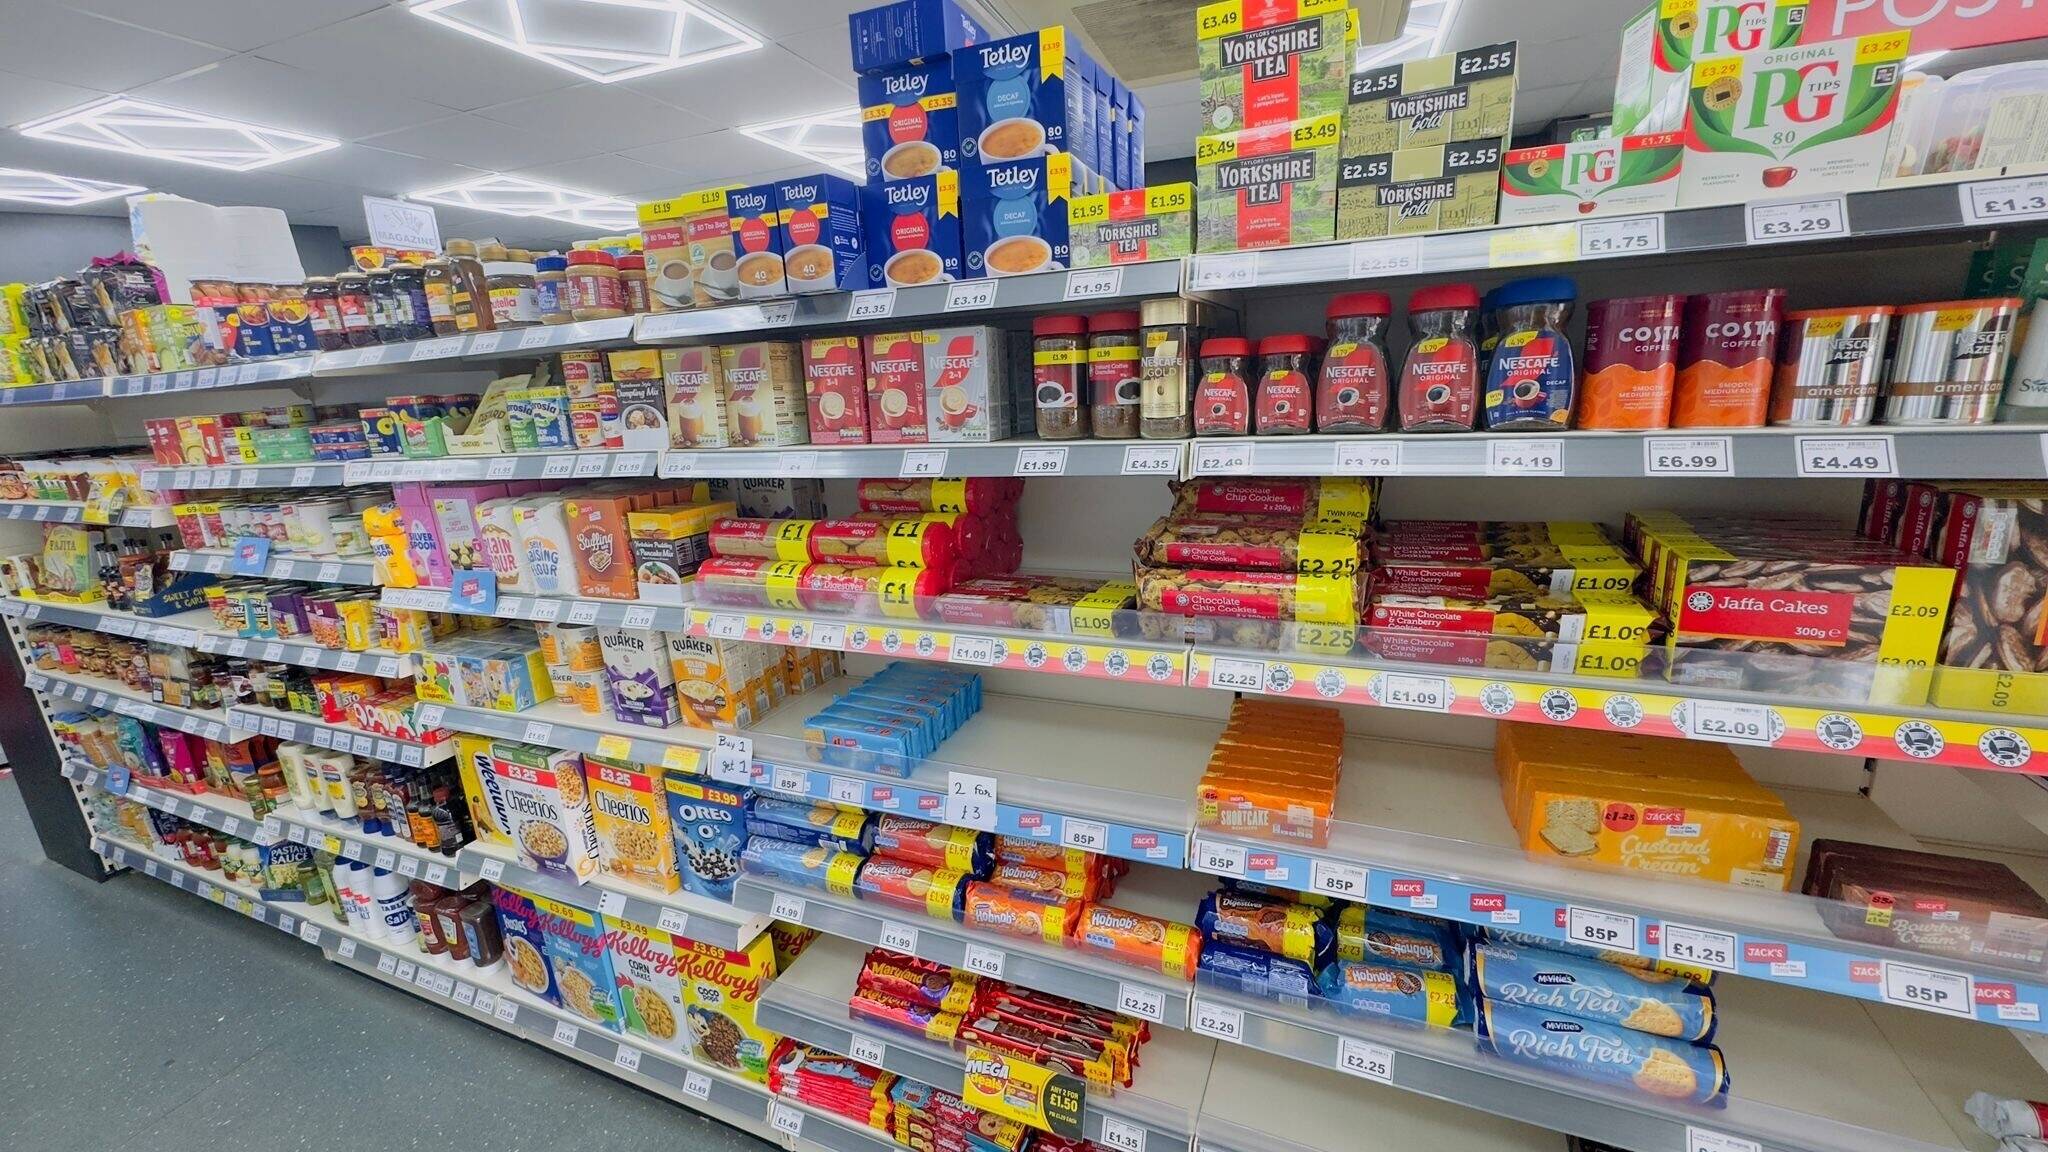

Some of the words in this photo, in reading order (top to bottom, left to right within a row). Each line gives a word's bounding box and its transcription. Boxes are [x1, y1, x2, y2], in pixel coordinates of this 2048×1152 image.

[1202, 12, 1237, 30] £3.49
[1222, 25, 1320, 64] YORKSHIRE
[979, 43, 1032, 69] Tetley
[1459, 51, 1511, 75] £2.55
[1763, 47, 1835, 65] ORIGINAL
[1253, 54, 1287, 79] TEA
[882, 74, 929, 96] Tetley
[1352, 74, 1398, 95] £2.55
[998, 92, 1019, 102] DECAF
[1744, 61, 1841, 129] PG
[1808, 79, 1841, 92] TIPS
[1390, 91, 1467, 119] YORKSHIRE
[893, 116, 922, 127] ORIGINAL
[1409, 110, 1447, 136] Gold
[1048, 127, 1062, 136] 80
[1294, 123, 1337, 141] £3.49
[1772, 131, 1796, 145] 80
[1197, 140, 1235, 159] £3.49
[1448, 147, 1497, 167] £2.55
[1220, 159, 1312, 189] YORKSHIRE
[1343, 161, 1388, 180] £2.55
[1568, 150, 1614, 185] PG
[987, 167, 1040, 190] Tetley
[782, 184, 817, 202] Tetley
[884, 184, 930, 206] Tetley
[1249, 182, 1281, 202] TEA
[1379, 181, 1454, 204] YORKSHIRE
[732, 194, 767, 211] Tetley
[1150, 193, 1185, 208] £1.95
[1003, 211, 1026, 221] DECAF
[1072, 205, 1104, 219] £1.95
[1398, 201, 1433, 225] Gold
[792, 222, 815, 230] ORIGINAL
[895, 225, 925, 236] ORIGINAL
[1098, 223, 1158, 243] YORKSHIRE
[1762, 217, 1832, 236] £3.29
[377, 231, 434, 247] MAGAZINE
[743, 230, 766, 238] ORIGINAL
[1054, 245, 1069, 255] 80
[1117, 239, 1138, 252] TEA
[1589, 236, 1648, 250] £1.75
[804, 264, 815, 273] 40
[945, 258, 958, 267] 80
[1073, 282, 1111, 294] £1.95
[952, 294, 987, 306] £3.19
[856, 304, 886, 315] £3.35
[1619, 325, 1680, 344] COSTA
[1705, 320, 1775, 339] COSTA
[1420, 373, 1461, 381] ORIGINAL
[240, 432, 251, 441] £1
[242, 449, 256, 457] £1
[1023, 461, 1057, 470] £1.99
[1131, 460, 1169, 469] £4.35
[1658, 455, 1717, 469] £6.99
[1812, 457, 1879, 469] £4.49
[1225, 493, 1248, 503] Chip
[1250, 494, 1285, 502] Cookies
[1226, 486, 1271, 495] Chocolate
[408, 533, 434, 542] SILVER
[781, 523, 805, 541] £1
[893, 522, 920, 538] £1
[50, 540, 76, 550] FAJITA
[410, 541, 437, 550] SPOON
[579, 533, 613, 550] Stuffing
[1191, 547, 1226, 556] Chocolate
[1576, 578, 1629, 590] £1.09
[884, 582, 909, 604] £1
[1191, 595, 1241, 606] Chocolate
[1192, 603, 1212, 613] Chip
[1214, 604, 1257, 614] Cookies
[1718, 596, 1765, 613] Jaffa
[1769, 599, 1829, 615] Cakes
[1891, 604, 1939, 618] £2.09
[573, 610, 593, 621] £1.35
[628, 615, 650, 625] £1.19
[1073, 616, 1111, 630] £1.09
[1389, 610, 1412, 619] White
[1414, 611, 1462, 621] Chocolate
[1297, 630, 1354, 649] £2.25
[1587, 626, 1645, 640] £1.09
[1794, 626, 1826, 639] 300g
[603, 636, 644, 651] QUAKER
[957, 648, 986, 659] £1.09
[1580, 655, 1639, 671] £1.09
[1218, 672, 1257, 686] £2.25
[1392, 690, 1437, 705] £1.09
[1702, 719, 1760, 736] £2.09
[719, 736, 736, 750] Buy
[508, 766, 538, 783] £3.25
[722, 760, 737, 774] get
[600, 768, 632, 786] £3.25
[955, 782, 966, 795] 2
[505, 789, 558, 820] Cheerios
[708, 790, 737, 806] £3.99
[594, 790, 650, 824] Cheerios
[679, 804, 733, 823] OREO
[962, 807, 981, 819] £3
[1221, 809, 1269, 828] SHORTCAKE
[1645, 810, 1684, 824] JACK'S
[1073, 833, 1095, 845] 85P
[271, 846, 299, 855] PASTA
[1620, 835, 1710, 859] Custard
[271, 853, 308, 865] SAUCE
[1209, 857, 1234, 869] 85P
[1622, 856, 1702, 875] Cream
[1326, 878, 1354, 891] 85P
[1393, 883, 1422, 893] JACK'S
[550, 903, 574, 917] £3.69
[1473, 897, 1503, 909] JACK'S
[386, 912, 408, 925] Salt
[976, 908, 1017, 925] Hobnobs
[1092, 913, 1137, 930] Hobnobs
[620, 919, 648, 934] £3.49
[1584, 925, 1618, 941] 85P
[1893, 919, 1972, 934] Bourbon
[886, 934, 911, 947] £1.99
[1900, 931, 1958, 945] Cream
[1672, 942, 1726, 963] £1.25
[1747, 945, 1784, 960] JACK'S
[628, 958, 650, 974] CORN
[972, 957, 999, 972] £1.69
[678, 954, 770, 1003] Kellogg's
[871, 961, 923, 985] Maryland
[1351, 966, 1395, 984] Hobnobs
[698, 986, 720, 997] COCO
[1499, 980, 1563, 1007] Rich
[1558, 985, 1625, 1016] Tea
[1905, 984, 1948, 1002] 85P
[1125, 999, 1156, 1014] £2.25
[1201, 1018, 1235, 1033] £2.29
[1509, 1027, 1574, 1059] Rich
[1568, 1033, 1633, 1066] Tea
[966, 1060, 1011, 1079] MEGA
[1346, 1055, 1386, 1074] £2.25
[970, 1072, 1002, 1090] deals
[1051, 1086, 1062, 1094] ANY
[1067, 1090, 1079, 1099] FOR
[1050, 1094, 1078, 1112] £1.50
[1109, 1129, 1138, 1147] £1.35
